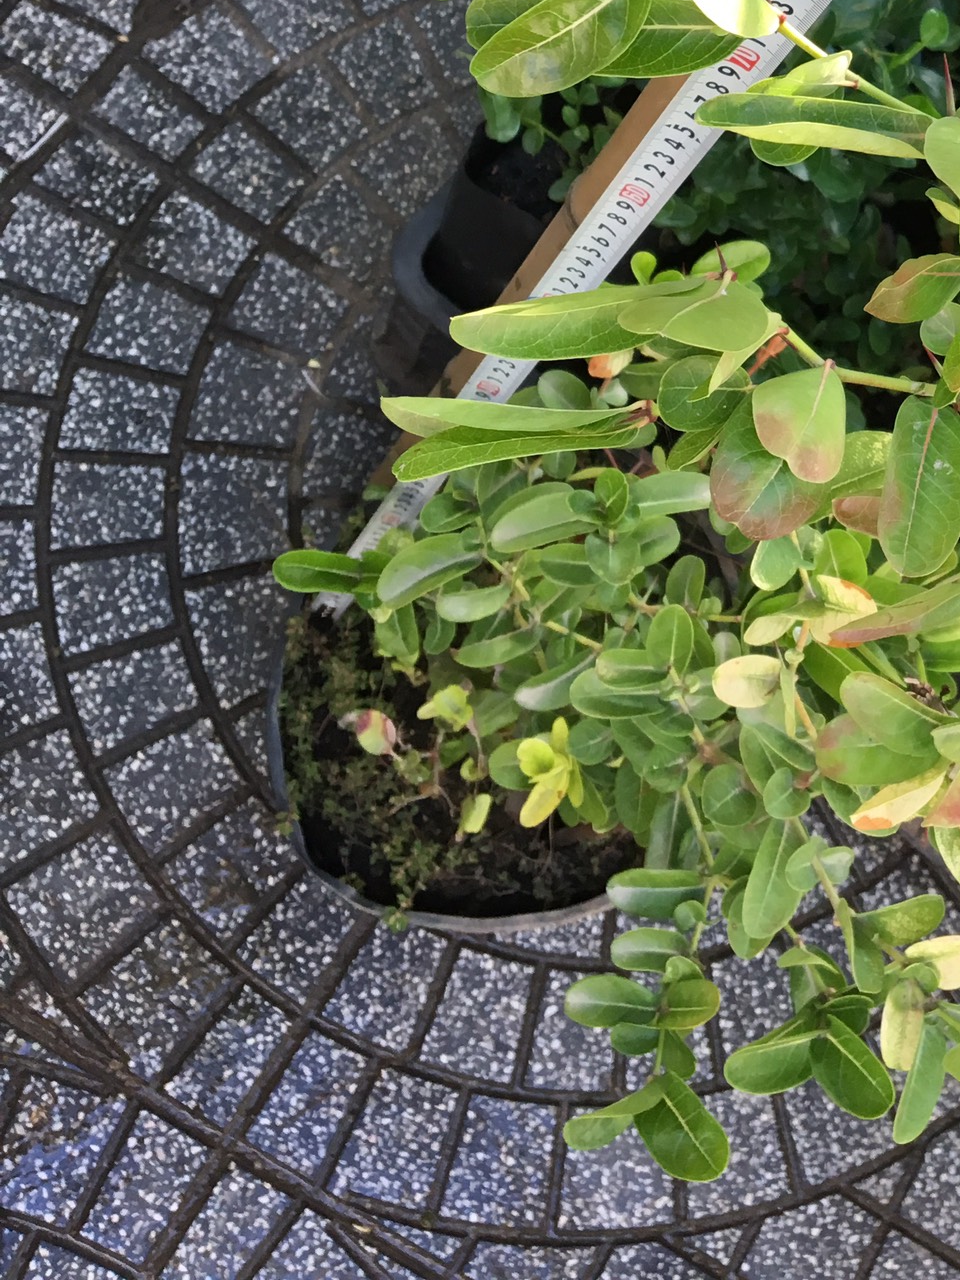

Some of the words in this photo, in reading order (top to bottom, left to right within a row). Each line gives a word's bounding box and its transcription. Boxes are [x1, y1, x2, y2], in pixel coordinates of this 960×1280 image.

[771, 1, 794, 15] 3
[706, 81, 729, 94] 8
[718, 66, 740, 80] 9
[673, 124, 695, 138] 5
[664, 138, 685, 150] 4
[653, 151, 675, 165] 3
[644, 164, 666, 178] 2
[634, 177, 654, 188] 1
[616, 201, 635, 213] 9
[607, 213, 627, 225] 8
[598, 223, 616, 237] 7
[590, 236, 609, 247] 6
[582, 245, 601, 258] 5
[575, 256, 594, 267] 4
[566, 267, 585, 278] 3
[559, 277, 578, 289] 2
